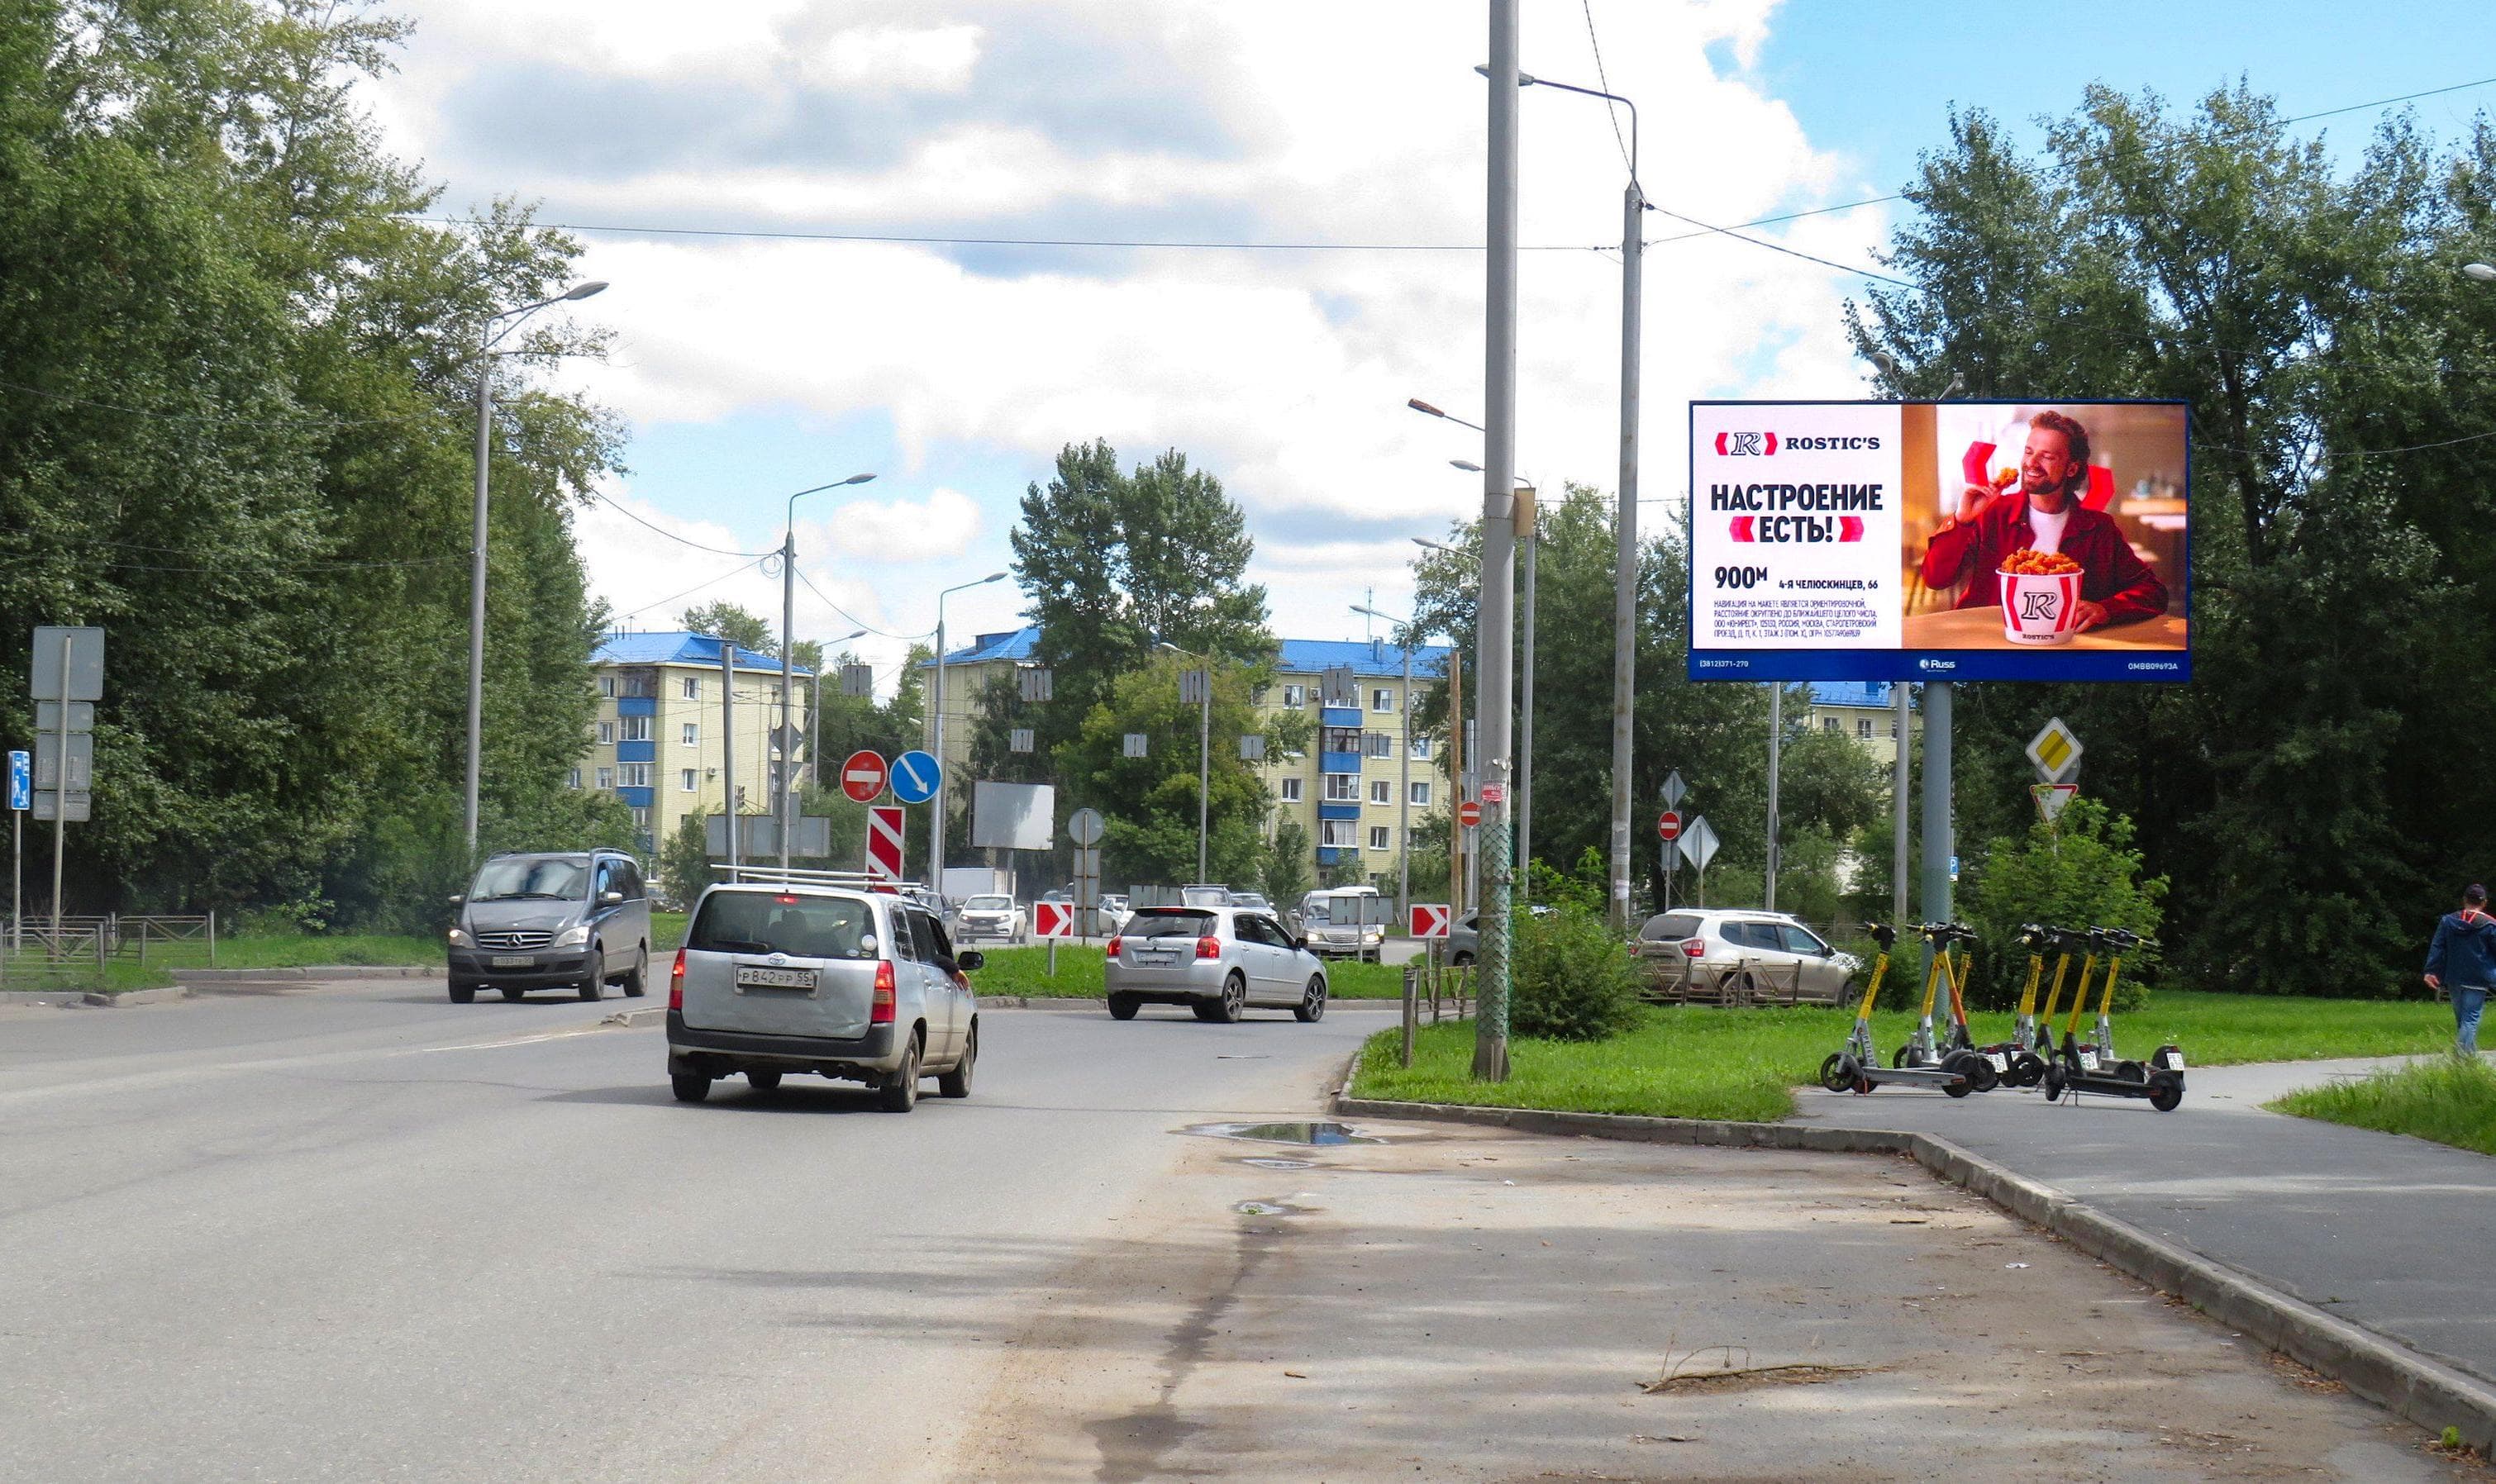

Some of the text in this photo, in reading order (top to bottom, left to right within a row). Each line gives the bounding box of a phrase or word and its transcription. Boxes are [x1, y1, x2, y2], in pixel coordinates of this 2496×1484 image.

[1785, 437, 1880, 449] ROSTIC'S
[1711, 483, 1883, 511] НАСТРОЕНИЕ
[1760, 516, 1833, 543] ЕСТЬ!
[1795, 579, 1866, 591] ЧЕЛЮСКИНЦЕВ,
[1868, 580, 1879, 589] 66
[1713, 600, 1747, 608] НАВИГАЦИЯ
[1748, 600, 1756, 608] НА
[1757, 600, 1779, 608] МАКЕТЕ
[1780, 600, 1808, 608] ЯВЛЯЕТСЯ
[1783, 610, 1792, 618] ДО
[1834, 610, 1856, 618] ЦЕЛОГО
[1713, 620, 1726, 628] ООО
[1930, 659, 1955, 668] Russ
